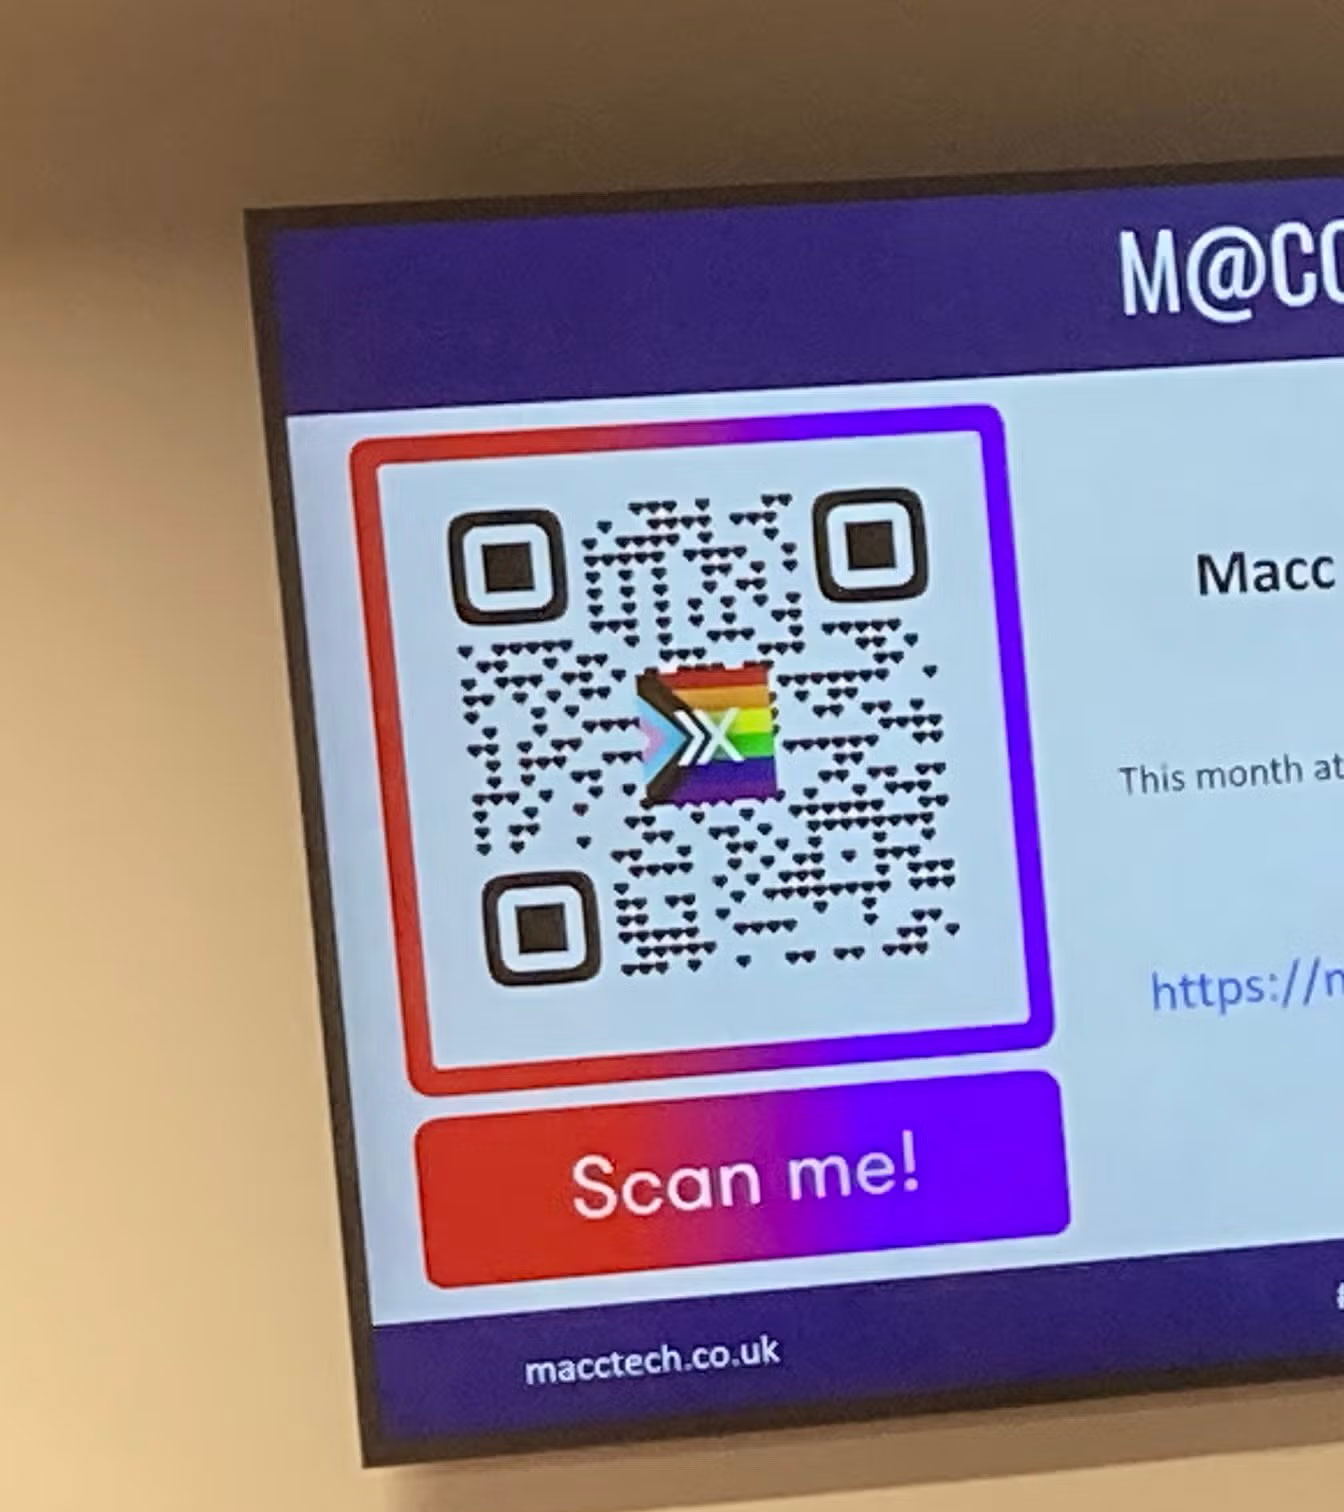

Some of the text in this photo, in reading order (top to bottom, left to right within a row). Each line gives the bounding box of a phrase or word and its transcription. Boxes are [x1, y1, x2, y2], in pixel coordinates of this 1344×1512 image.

[1198, 551, 1336, 595] Macc
[1118, 760, 1186, 796] This
[1198, 753, 1303, 790] month
[1314, 751, 1344, 781] at
[572, 1129, 919, 1221] Scan me!
[526, 1335, 780, 1386] macctech.co.uk
